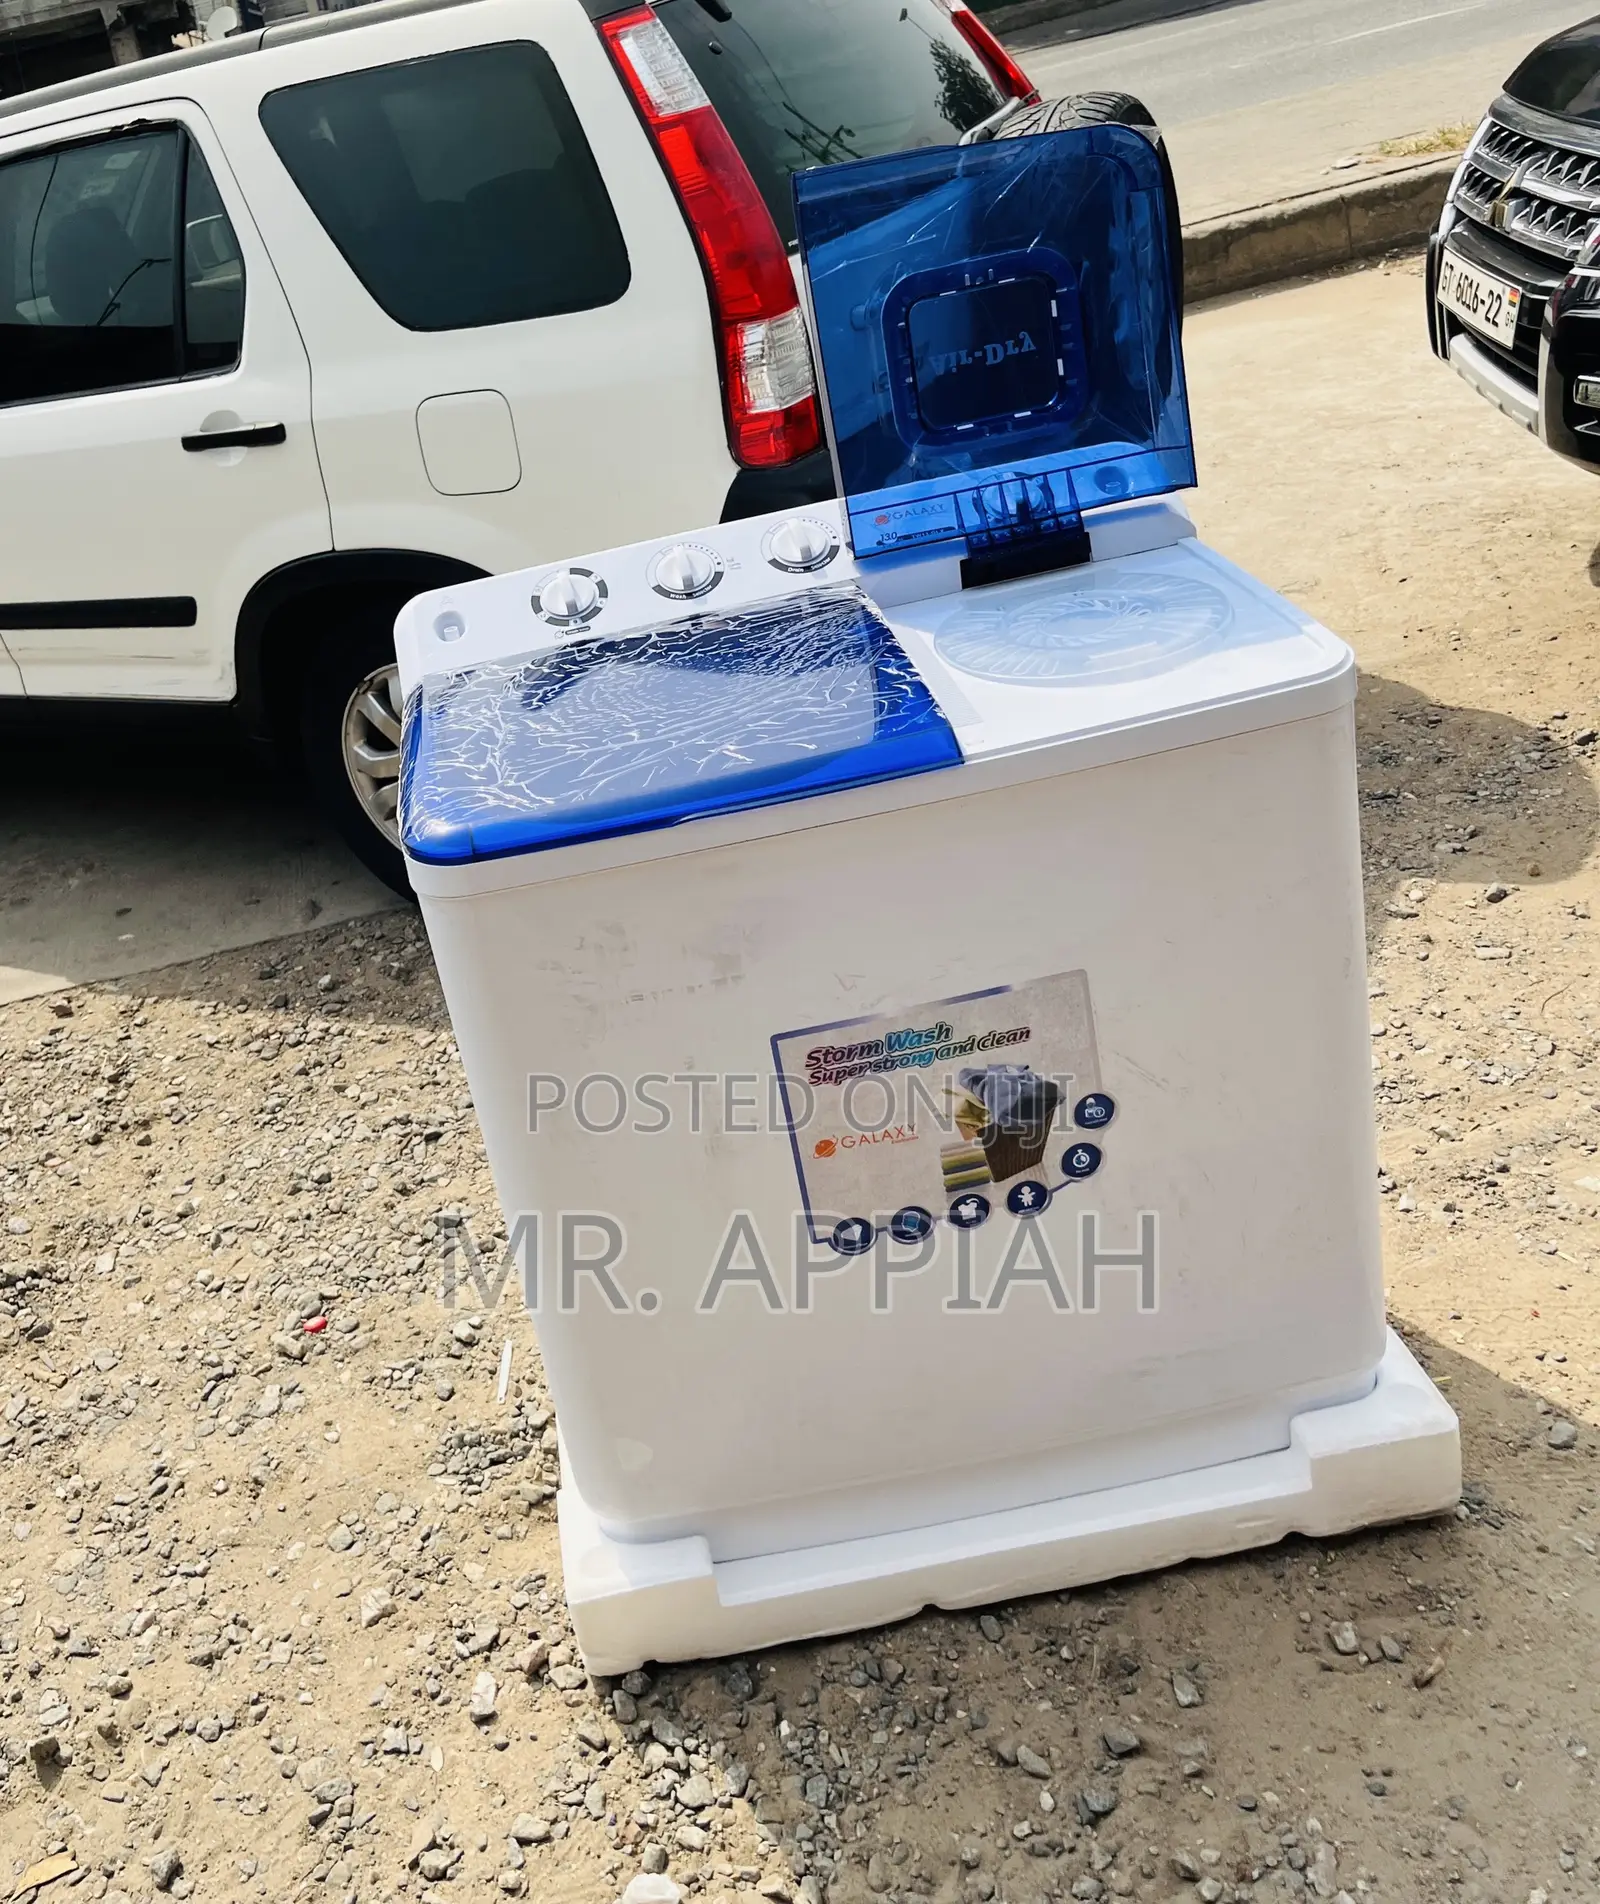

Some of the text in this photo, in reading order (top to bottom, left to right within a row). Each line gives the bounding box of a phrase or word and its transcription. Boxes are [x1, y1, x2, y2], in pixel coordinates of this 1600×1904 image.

[1442, 261, 1502, 328] GT 6016-22
[1505, 311, 1515, 330] GH
[892, 503, 944, 520] GALAXY
[805, 1021, 953, 1070] Storm Wash
[808, 1026, 1032, 1087] Super strong and clean
[841, 1123, 916, 1148] GALAXY
